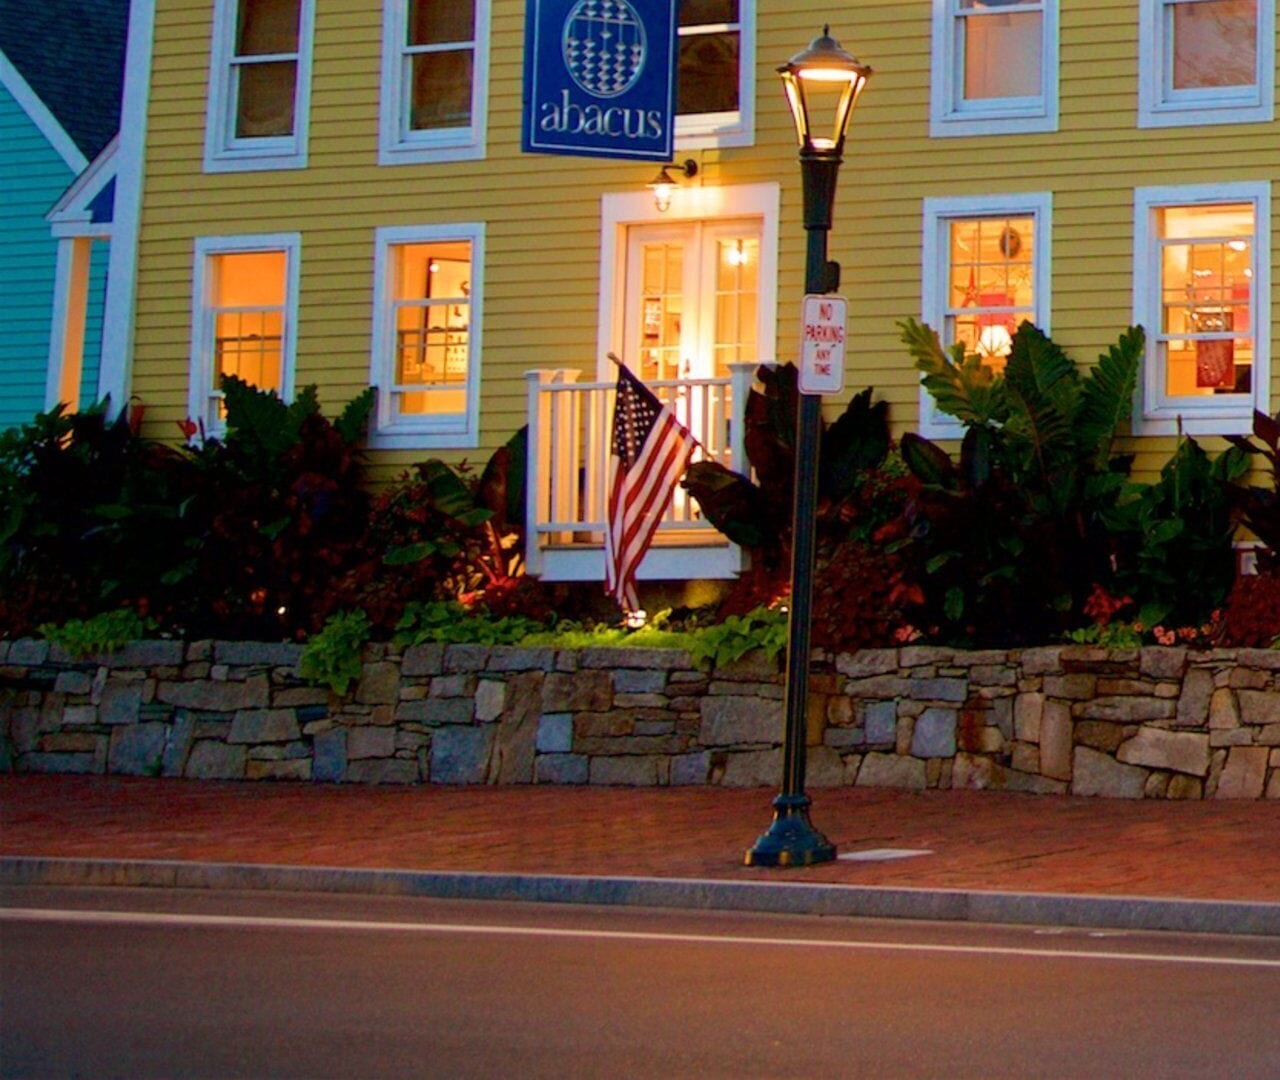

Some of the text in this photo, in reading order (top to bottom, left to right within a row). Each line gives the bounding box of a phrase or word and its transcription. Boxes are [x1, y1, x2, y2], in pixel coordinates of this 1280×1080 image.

[541, 89, 662, 139] abacus
[806, 325, 844, 343] PARKING
[816, 350, 831, 361] ANY
[815, 363, 831, 376] TIME
